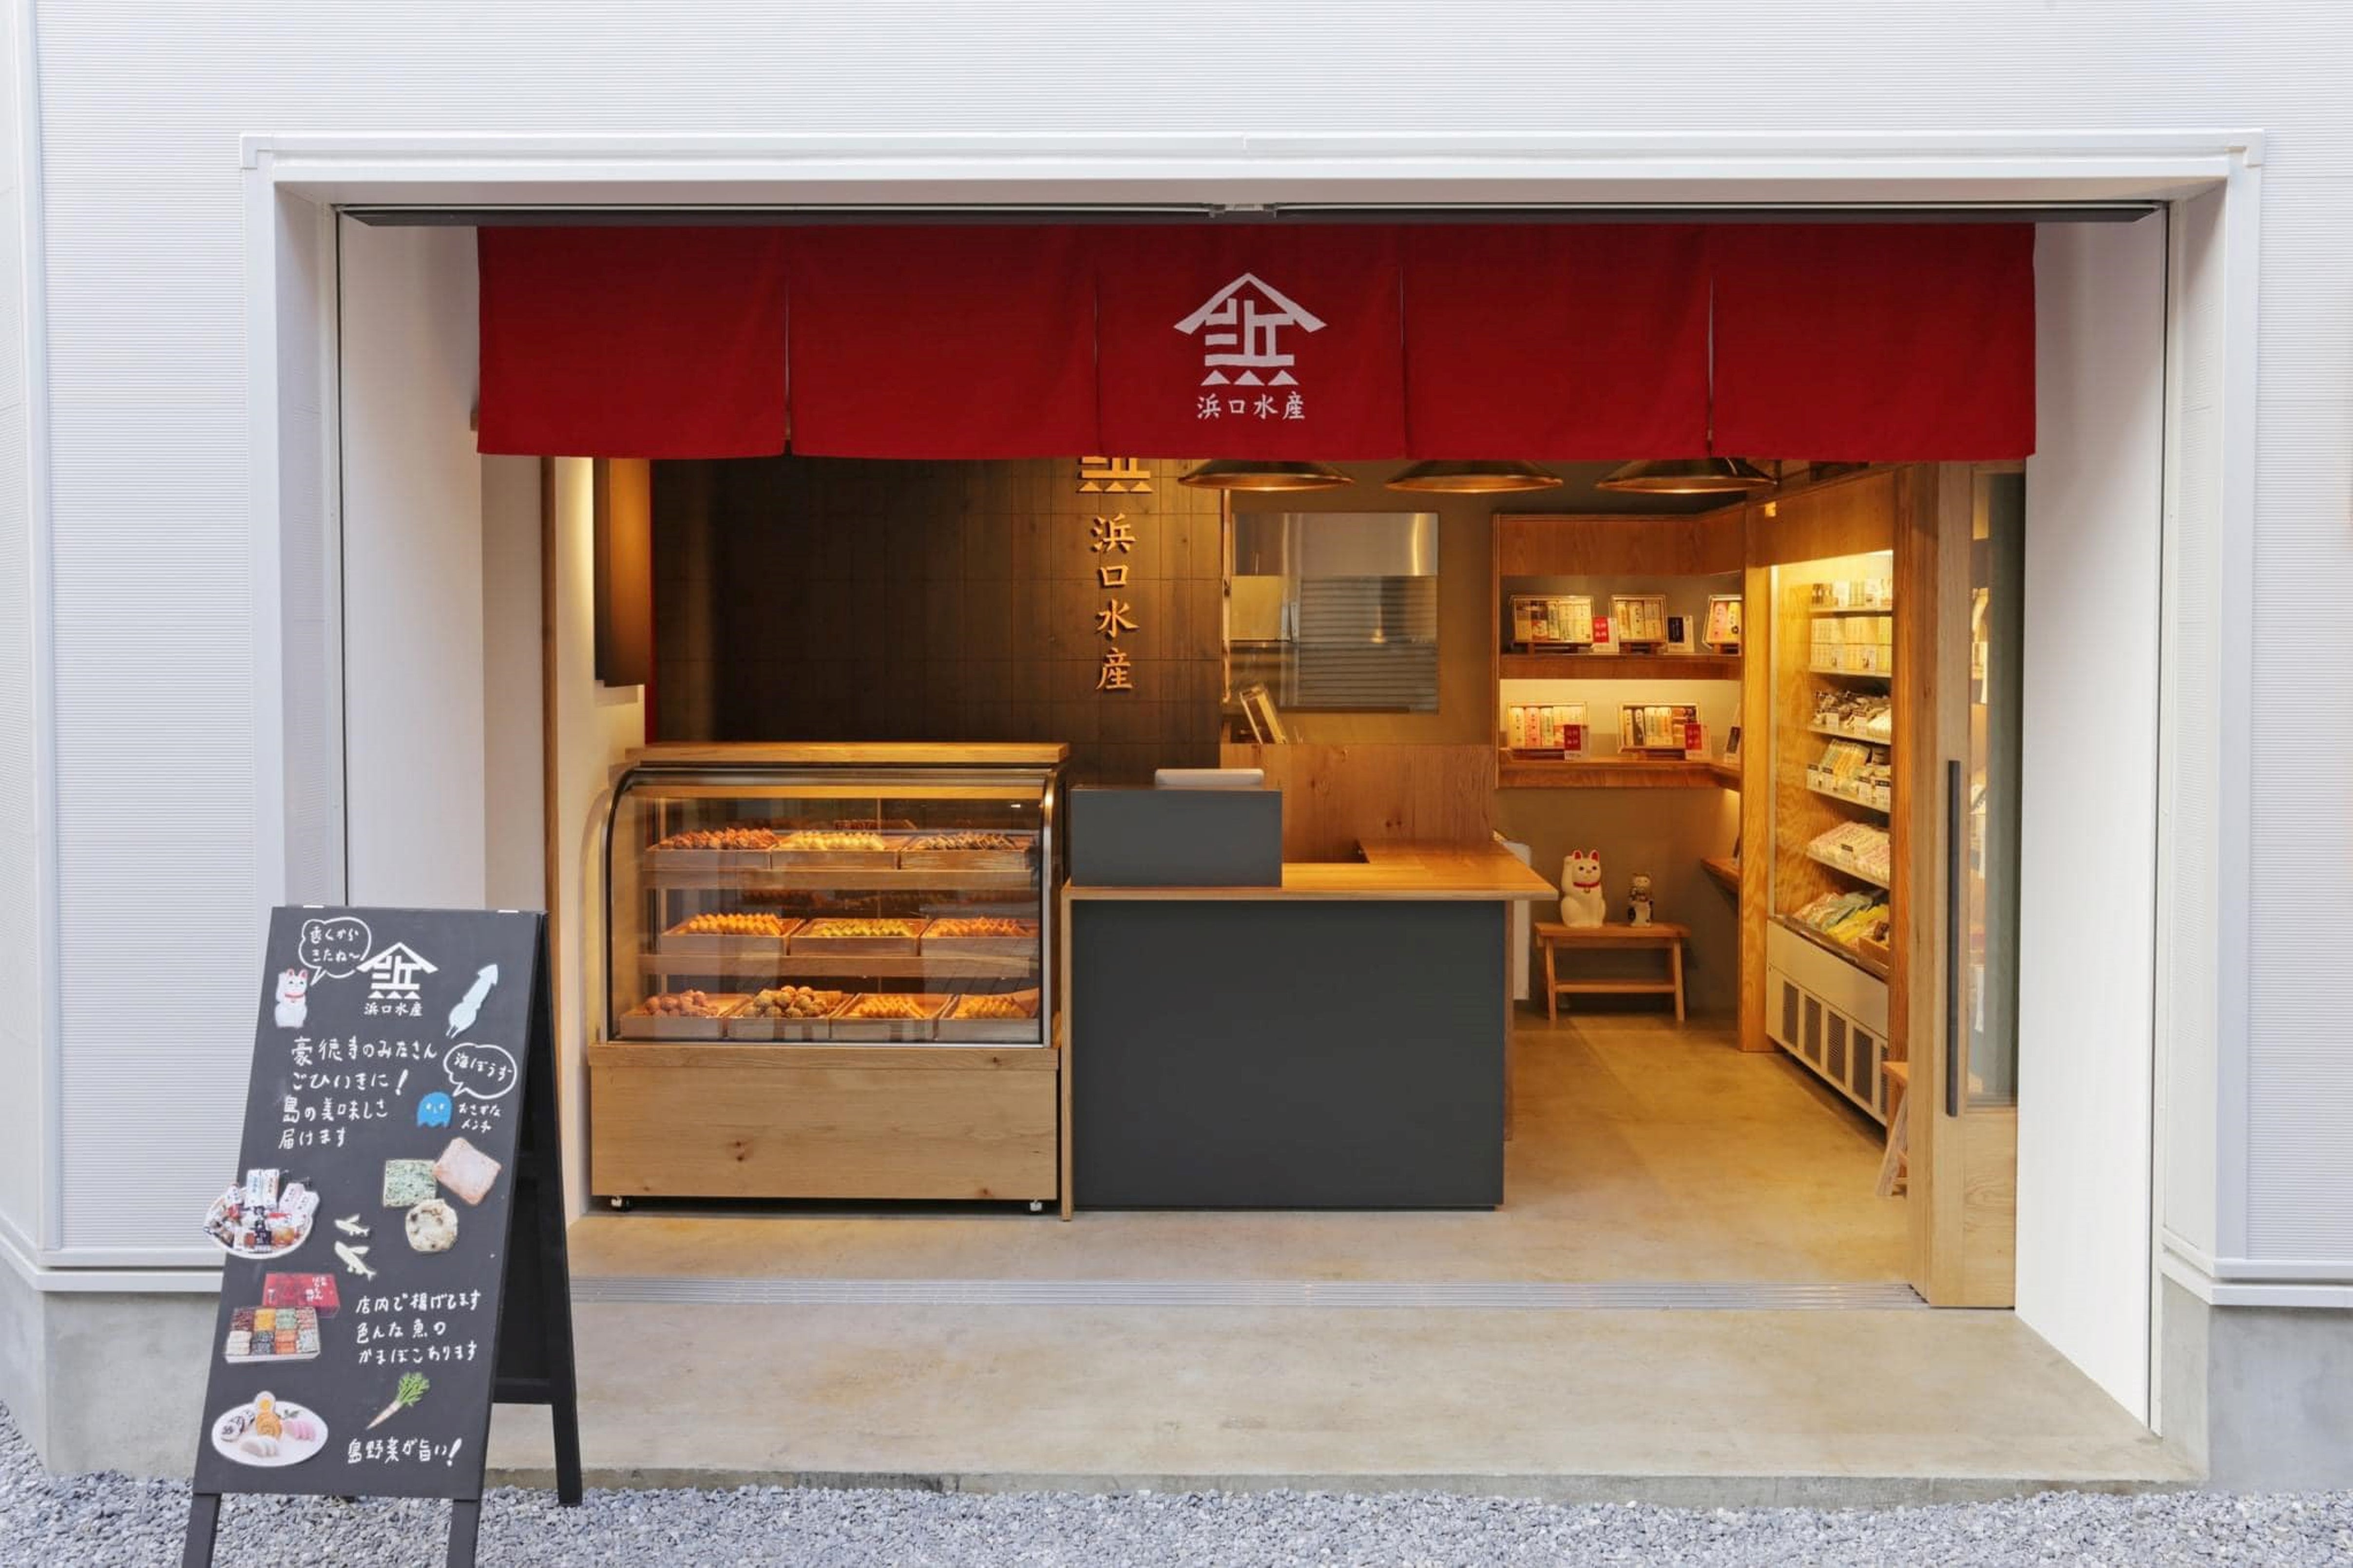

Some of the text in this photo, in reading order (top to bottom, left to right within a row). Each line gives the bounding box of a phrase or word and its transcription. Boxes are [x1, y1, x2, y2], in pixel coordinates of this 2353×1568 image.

[1197, 391, 1306, 420] 浜口水産
[1091, 513, 1139, 690] 浜口水産
[364, 1001, 423, 1017] 浜口水産
[291, 1035, 438, 1067] 豪徳寺のみなさん
[282, 1094, 388, 1123] 島の美味しさ
[278, 1127, 346, 1149] 届けます
[355, 1289, 481, 1314] 店内で揚げてます
[357, 1318, 446, 1344] 色んな魚の
[347, 1436, 462, 1467] 島野菜が旨い!
